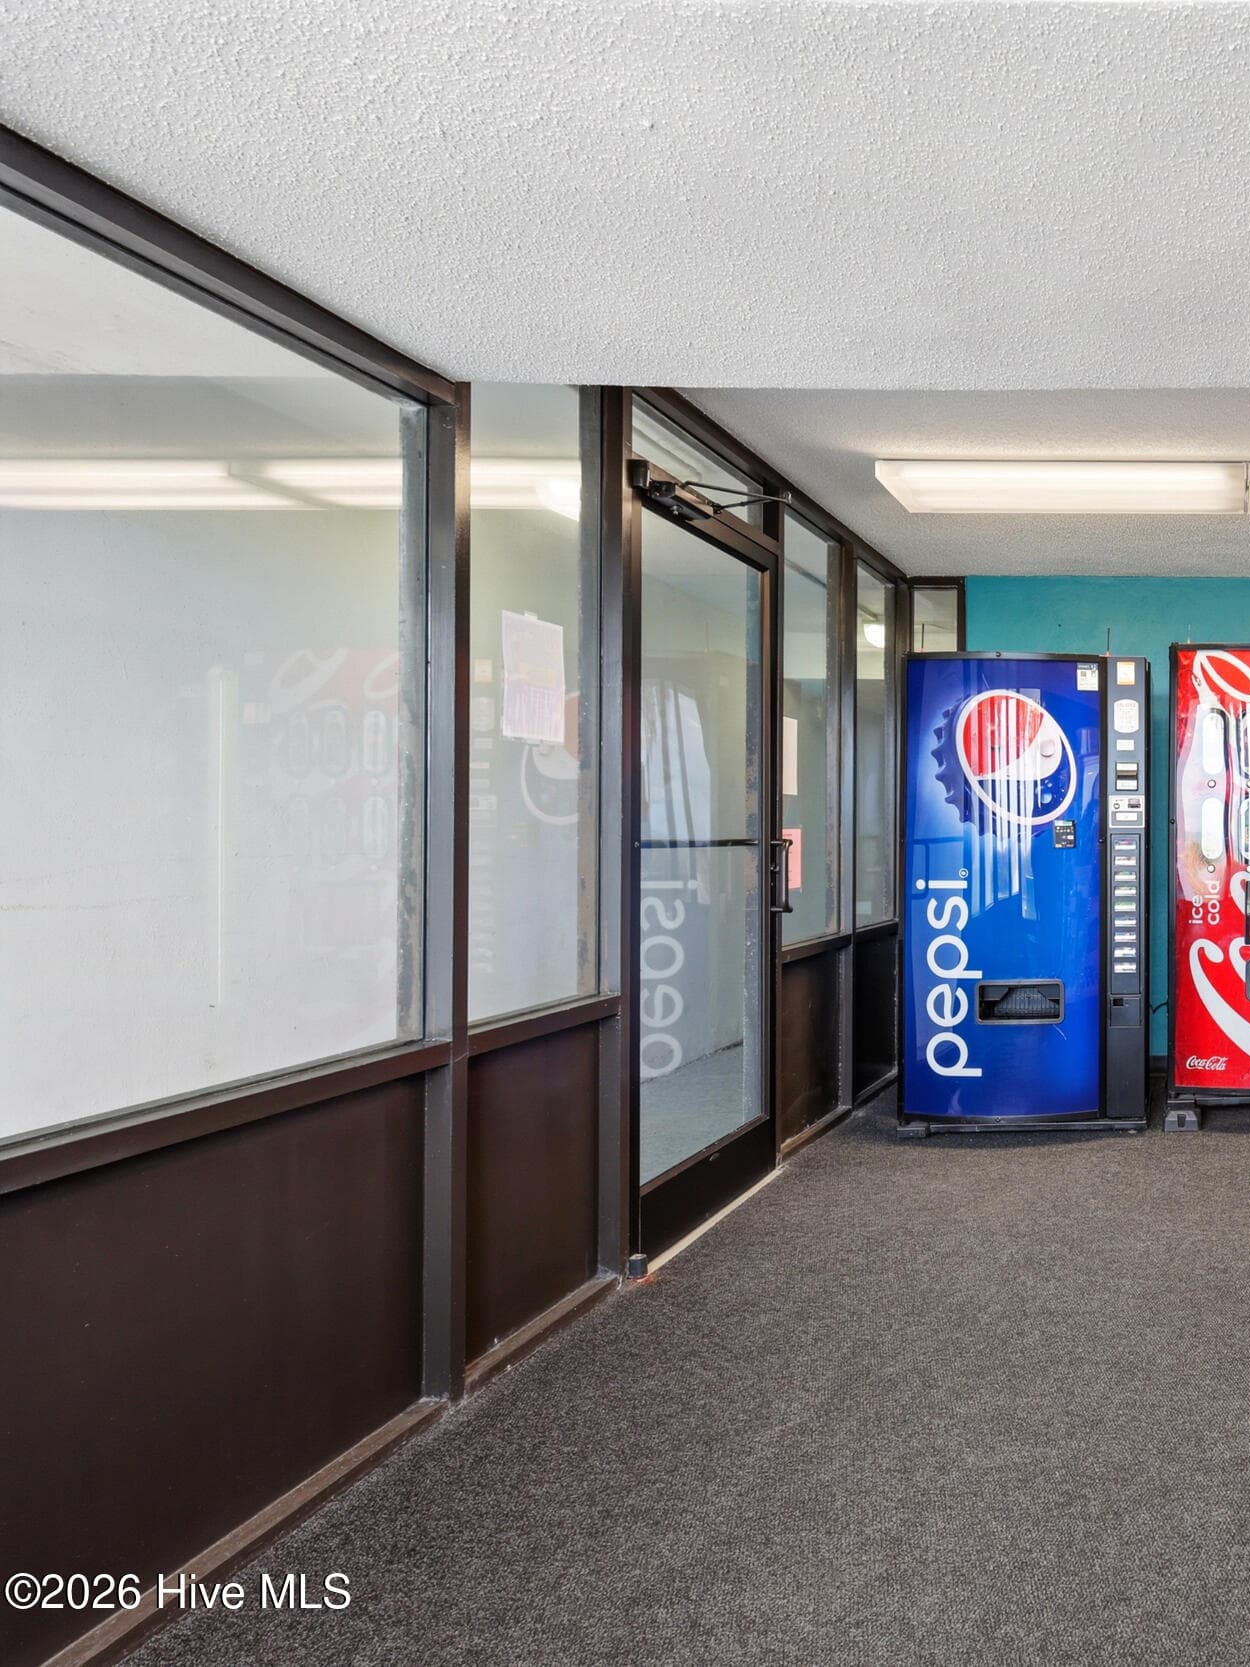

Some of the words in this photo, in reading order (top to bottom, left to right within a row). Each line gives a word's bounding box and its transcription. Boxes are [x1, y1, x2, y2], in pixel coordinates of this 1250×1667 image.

[1188, 895, 1204, 924] ice
[1203, 880, 1220, 926] cold
[915, 878, 983, 1077] pepsi
[1186, 1055, 1229, 1071] Coca-Cola
